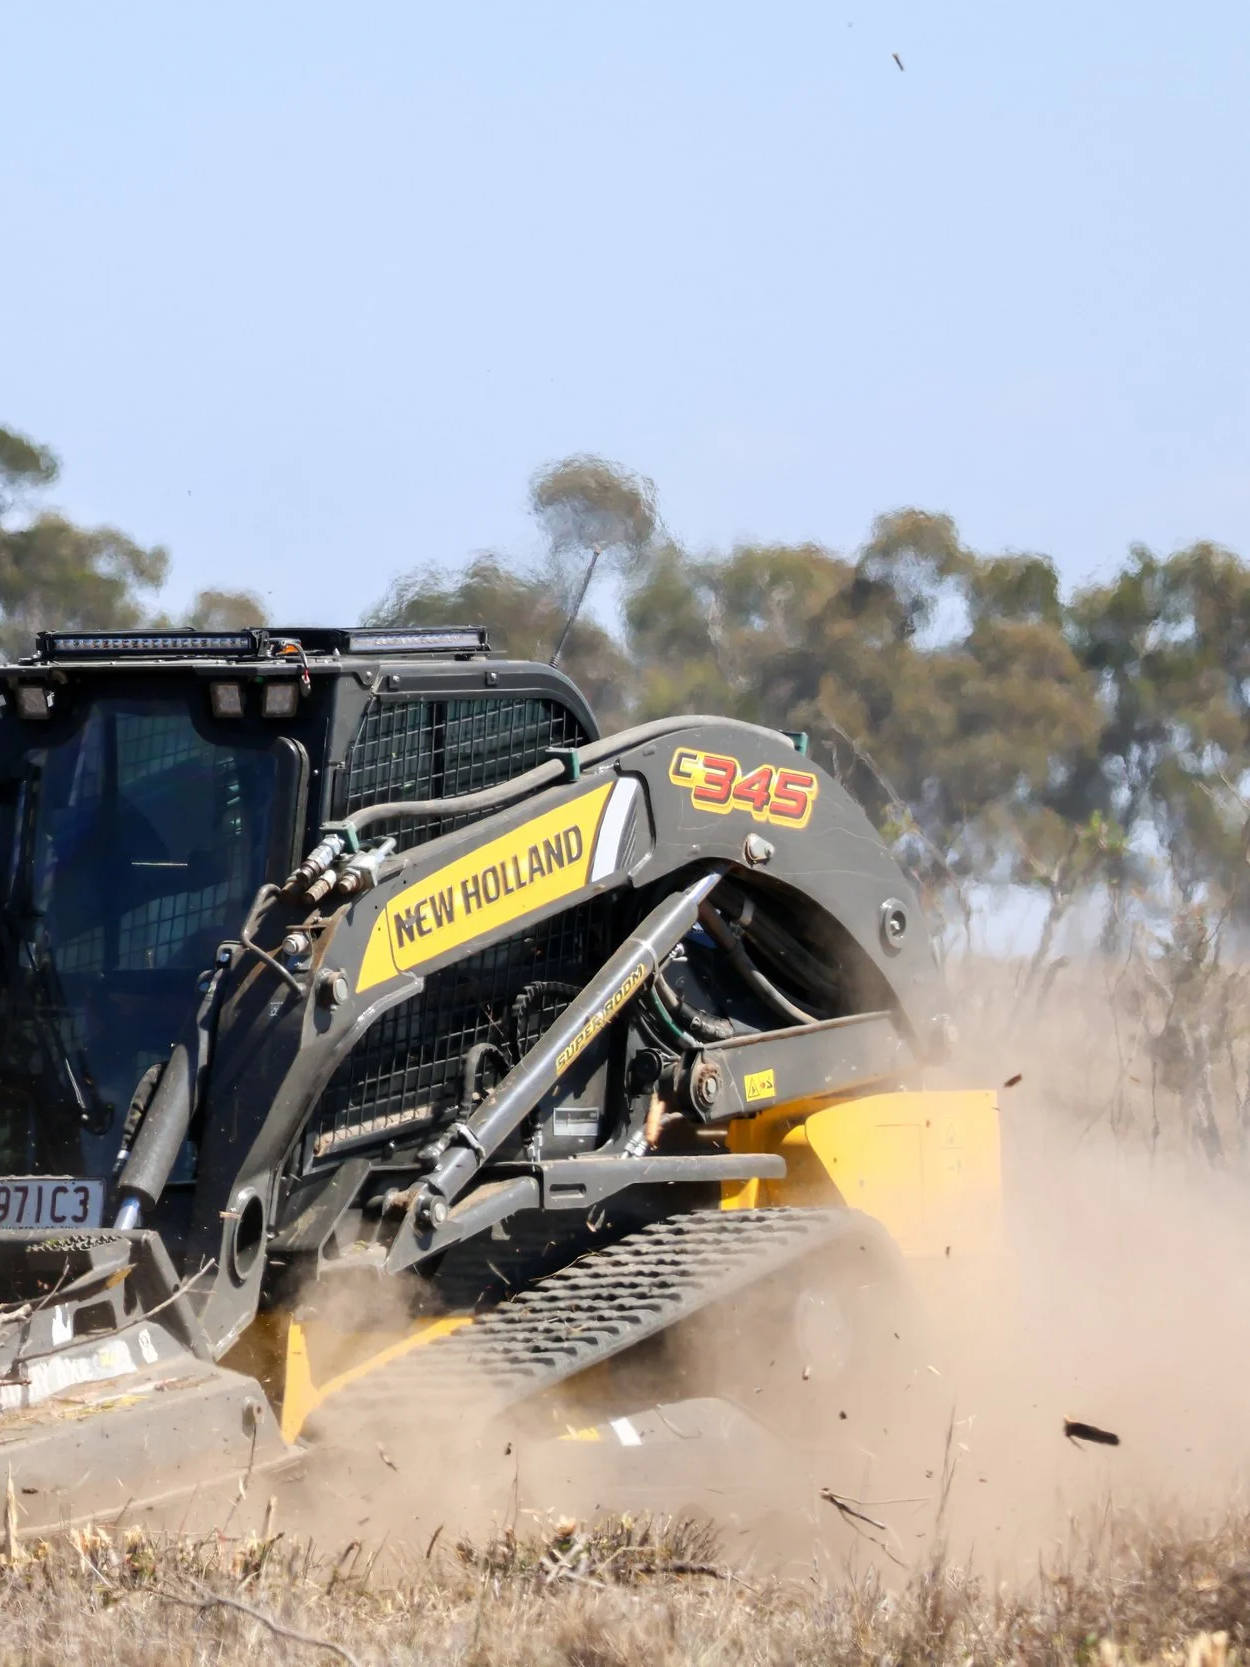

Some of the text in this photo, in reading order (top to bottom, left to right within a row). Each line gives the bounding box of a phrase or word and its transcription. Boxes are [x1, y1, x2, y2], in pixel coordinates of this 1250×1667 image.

[670, 749, 817, 824] C345
[393, 825, 583, 949] NEW HOLLAND
